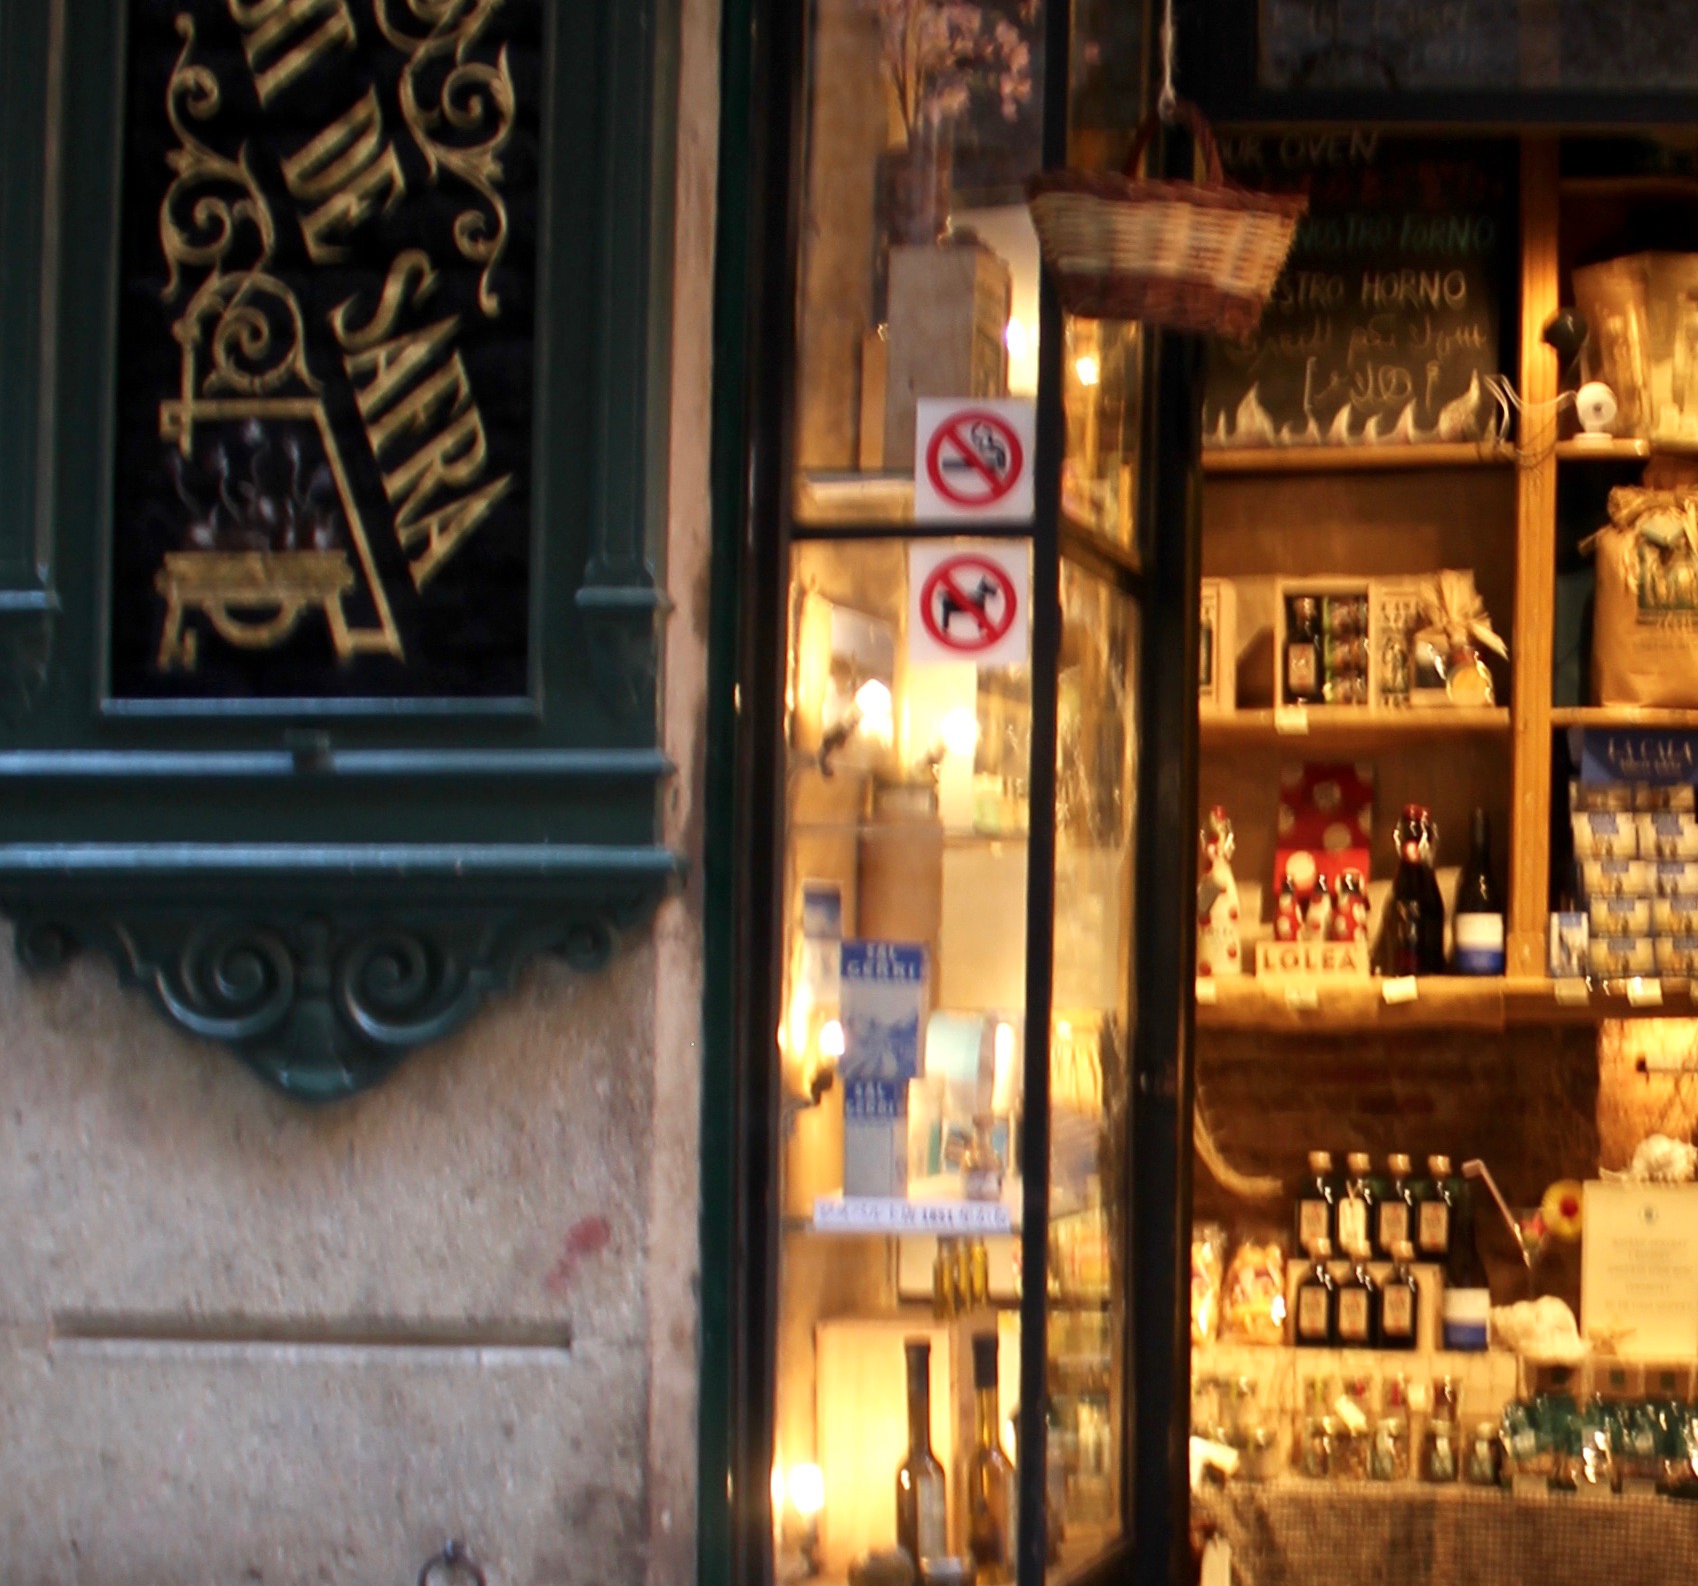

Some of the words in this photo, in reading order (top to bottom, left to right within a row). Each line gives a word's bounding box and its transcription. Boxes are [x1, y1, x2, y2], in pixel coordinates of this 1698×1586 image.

[282, 87, 407, 261] DE
[1361, 266, 1467, 311] HORNO
[333, 253, 511, 591] SAFRA
[1263, 947, 1357, 971] LOLEA
